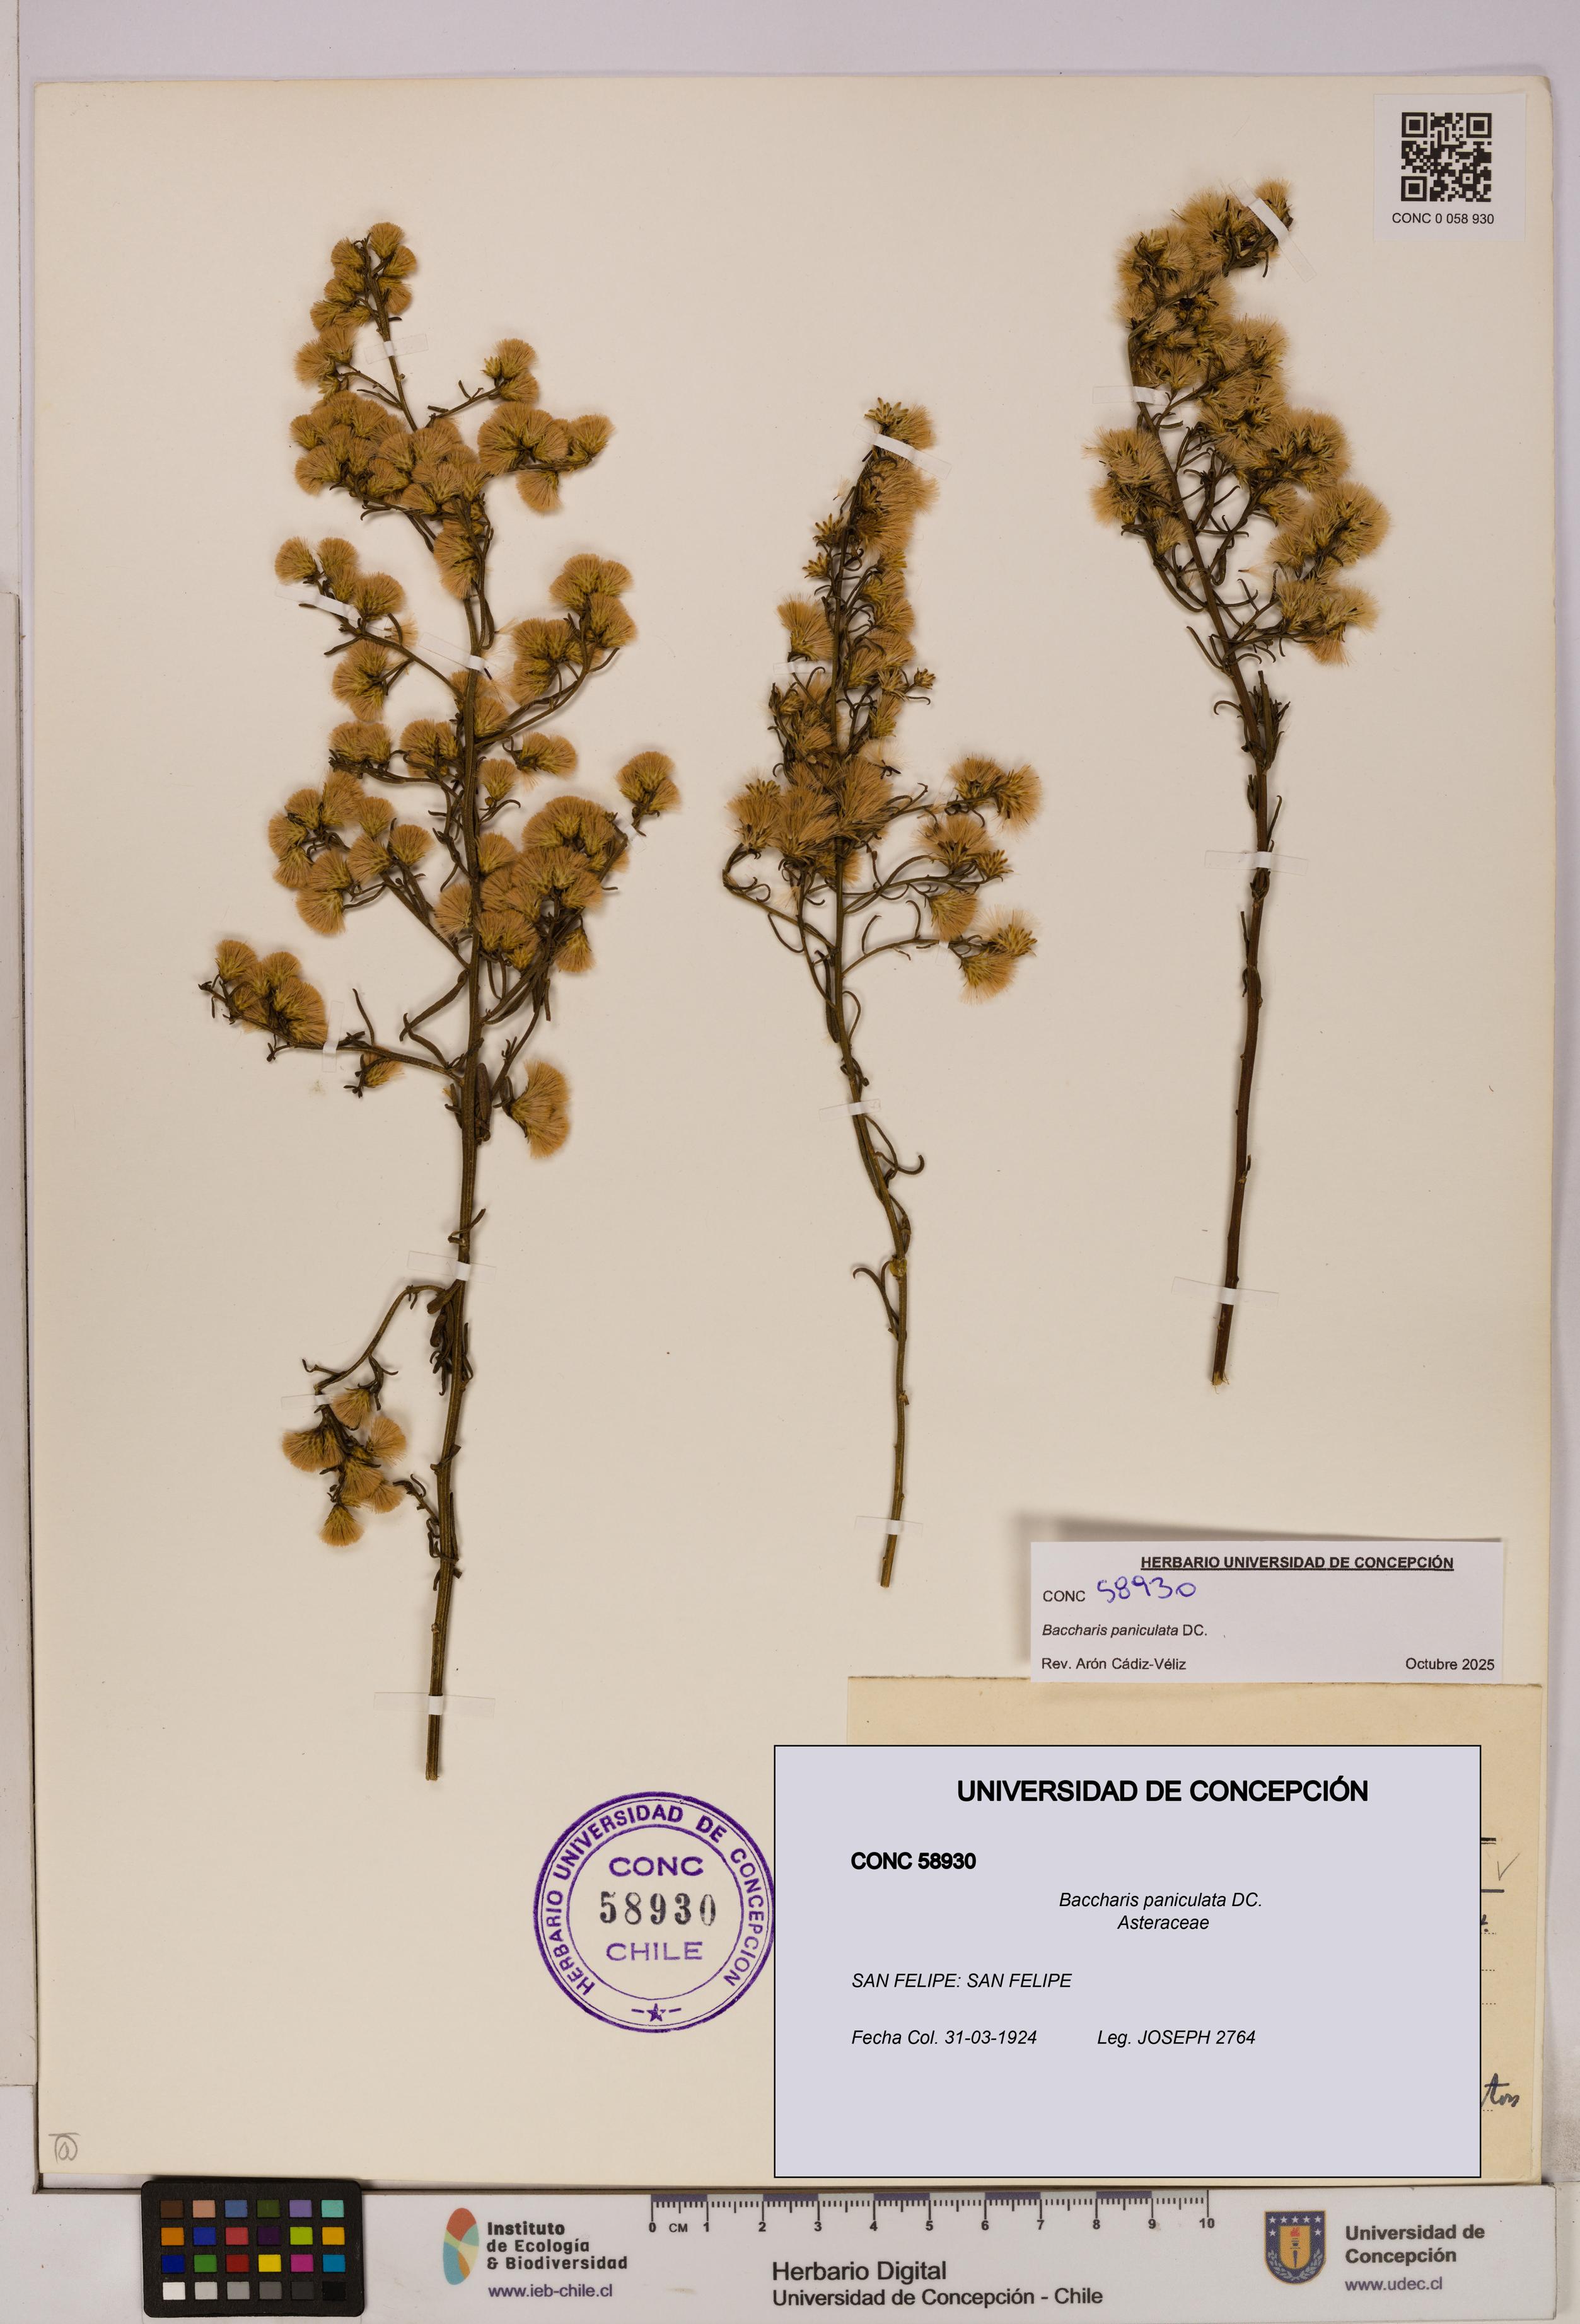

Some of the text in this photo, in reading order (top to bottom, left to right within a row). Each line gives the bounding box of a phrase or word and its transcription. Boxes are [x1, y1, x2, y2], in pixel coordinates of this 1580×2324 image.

[1392, 212, 1494, 224] CONC 0 058 930
[1141, 1554, 1454, 1570] HERBARIO UNIVERSIDAD DE CONCEPCIÓN
[1043, 1576, 1197, 1604] CONC 58930
[1042, 1624, 1207, 1639] Baccharis paniculata DC.
[1042, 1657, 1187, 1670] Rev. Arón Cádiz-Véliz
[1405, 1657, 1495, 1671] Octubre 2025
[608, 1856, 704, 1877] CONC
[546, 1805, 765, 1996] HERBARIO UNIVERSIDAD DE CONCEPCION
[599, 1891, 716, 1926] 58930
[606, 1941, 703, 1961] CHILE
[487, 2220, 566, 2236] Instituto
[648, 2218, 1216, 2233] 0 CM 1 2 3 4 5 6 7 8 9 10
[1345, 2224, 1485, 2241] Universidad de
[486, 2238, 590, 2257] de Ecología
[487, 2255, 628, 2270] & Biodiversidad
[1345, 2247, 1456, 2267] Concepción
[772, 2260, 946, 2285] Herbario Digital
[488, 2283, 613, 2298] www.ieb-chile.cl
[1344, 2276, 1443, 2292] www.udec.cl
[773, 2289, 885, 2306] Universidad
[892, 2289, 915, 2306] de
[921, 2288, 1035, 2309] Concepción
[1054, 2287, 1103, 2304] Chile
